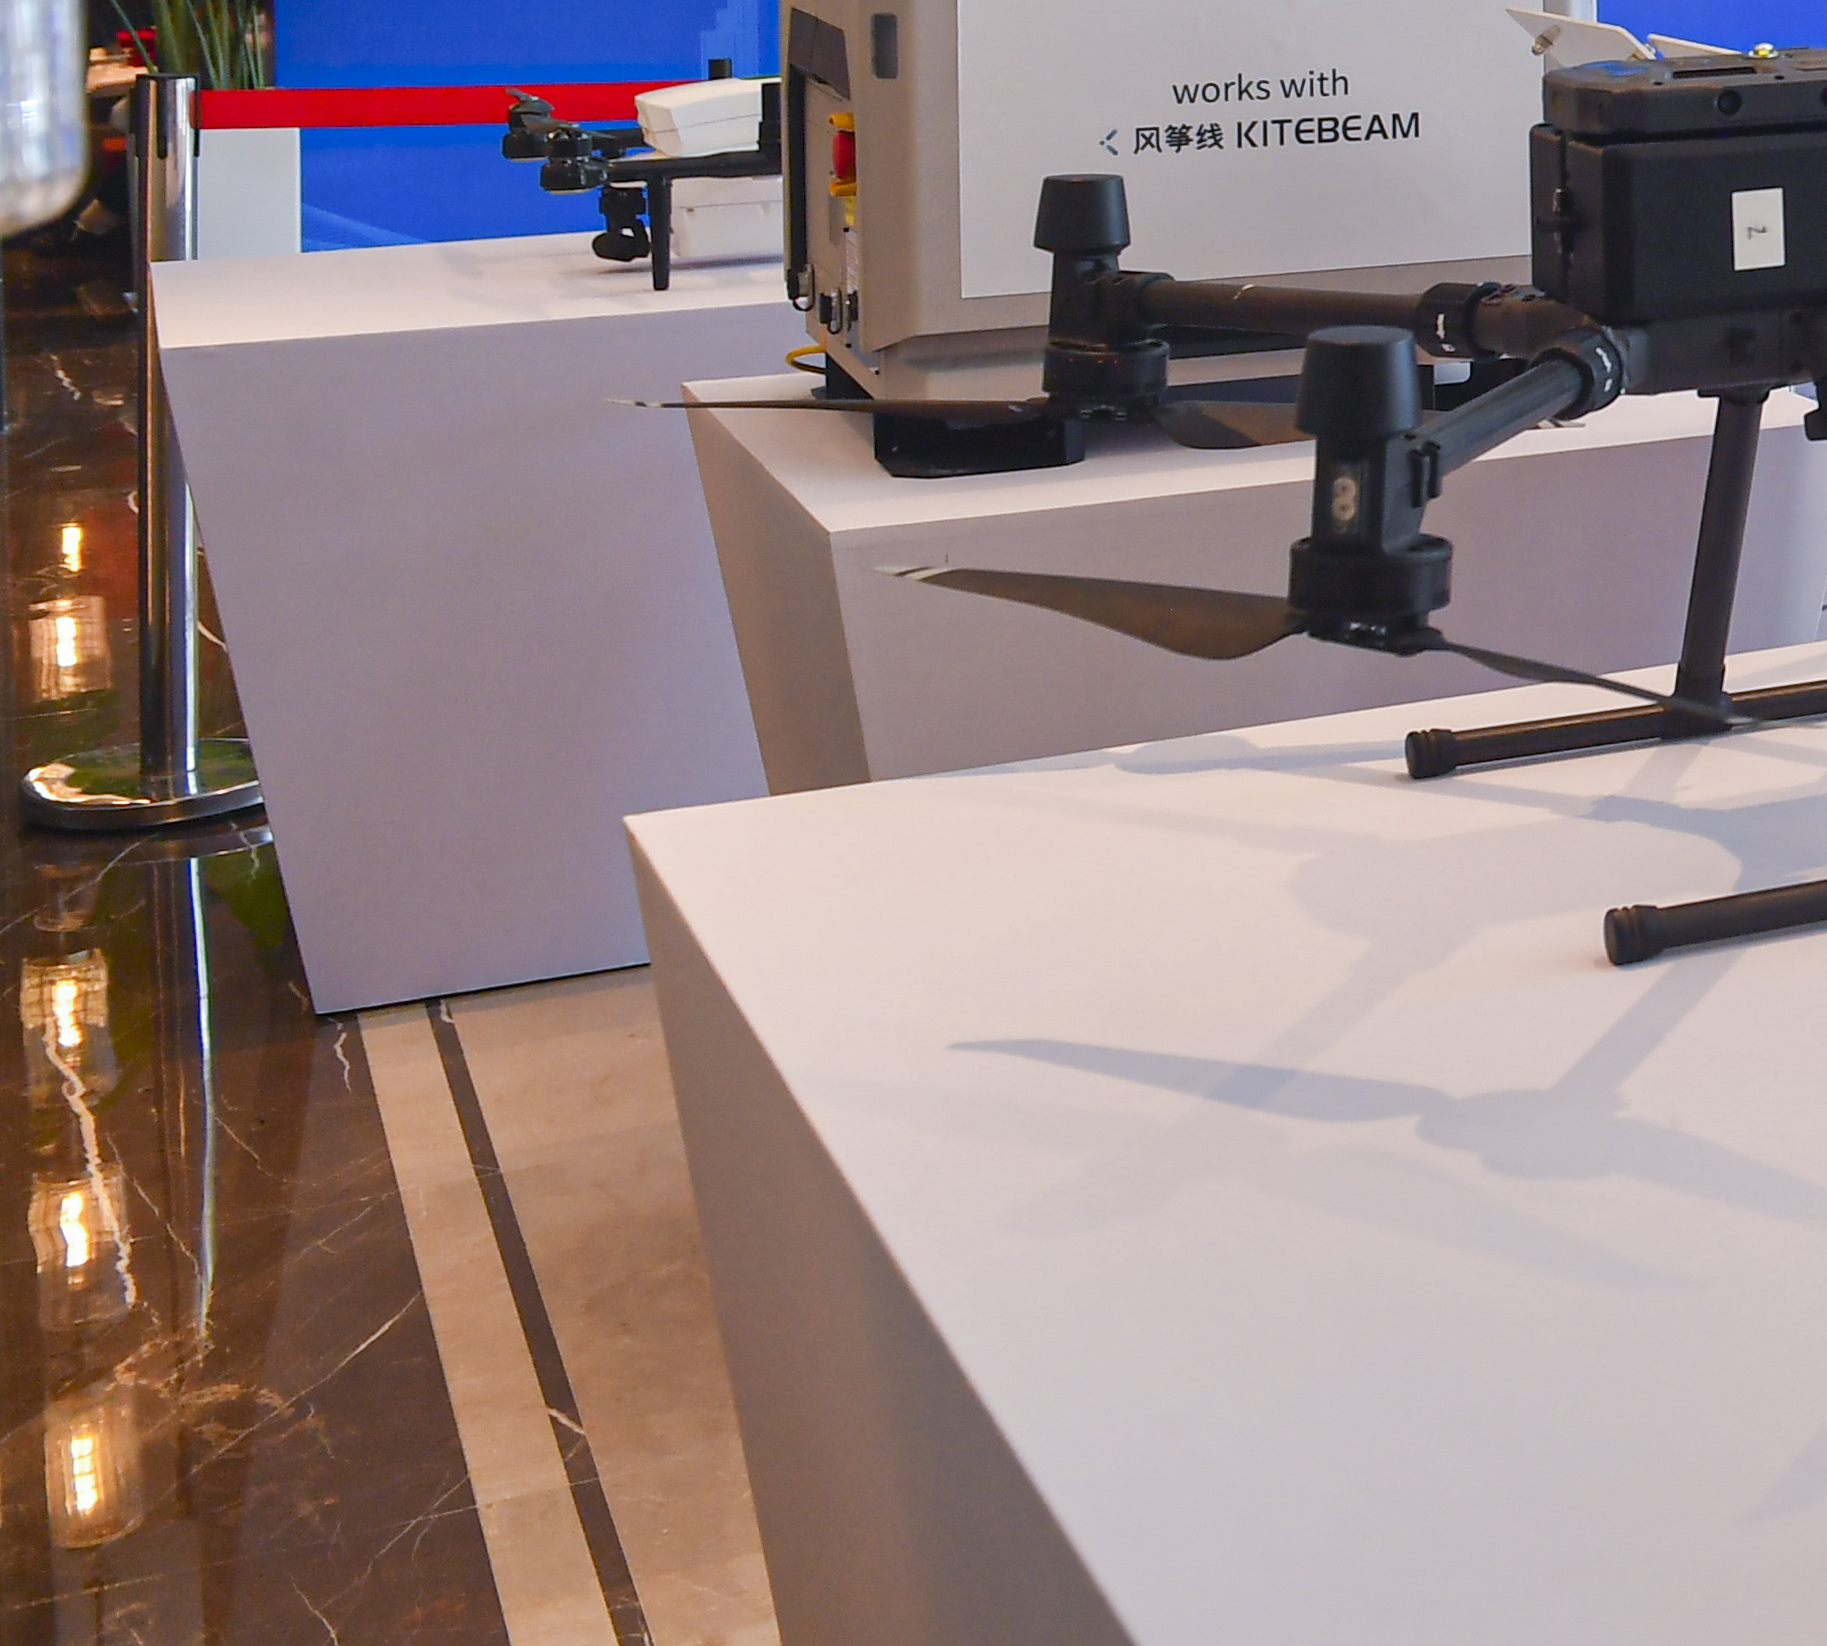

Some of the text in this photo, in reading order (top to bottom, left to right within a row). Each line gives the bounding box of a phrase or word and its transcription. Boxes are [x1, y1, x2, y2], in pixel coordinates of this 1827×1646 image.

[1172, 67, 1350, 105] works with
[1133, 111, 1421, 155] 风筝线 KITEBEAM
